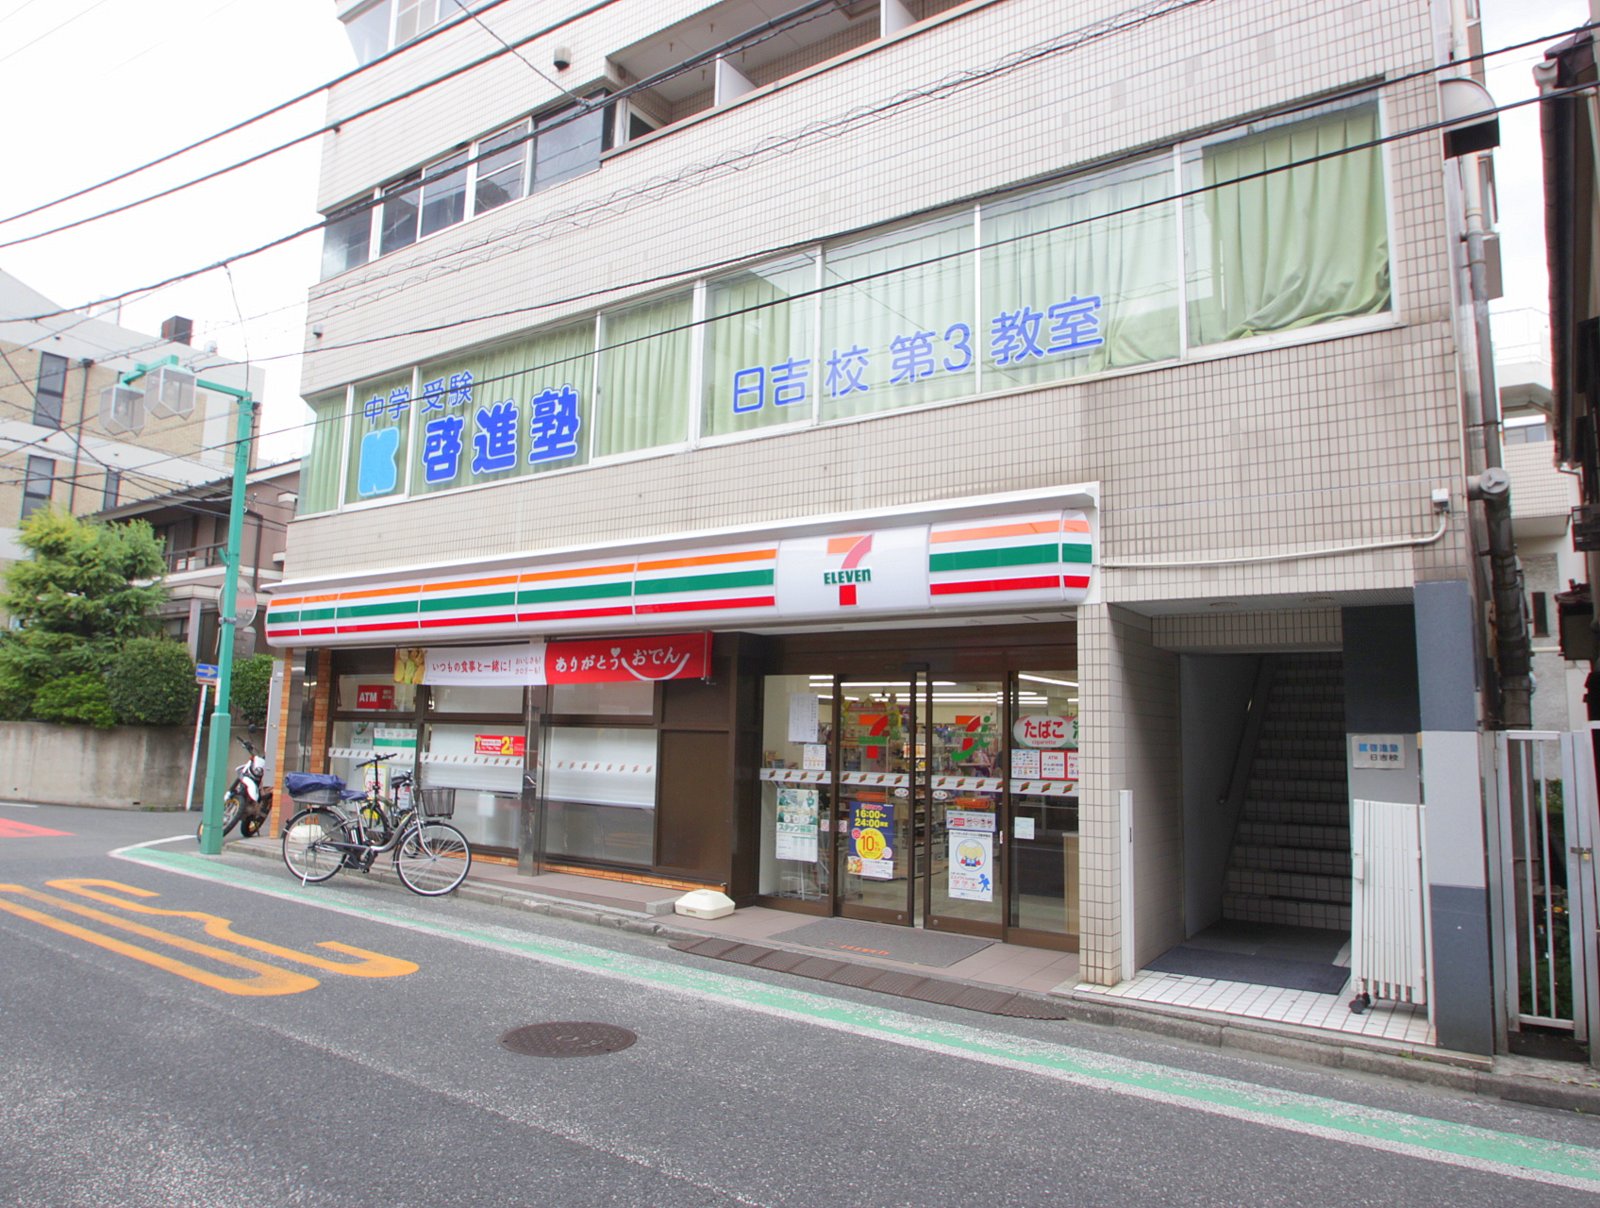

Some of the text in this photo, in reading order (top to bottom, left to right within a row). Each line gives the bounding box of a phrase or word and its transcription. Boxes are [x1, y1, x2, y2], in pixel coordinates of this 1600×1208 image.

[423, 383, 581, 484] 啓進塾
[359, 691, 377, 703] ATM
[1024, 720, 1064, 738] たばこ
